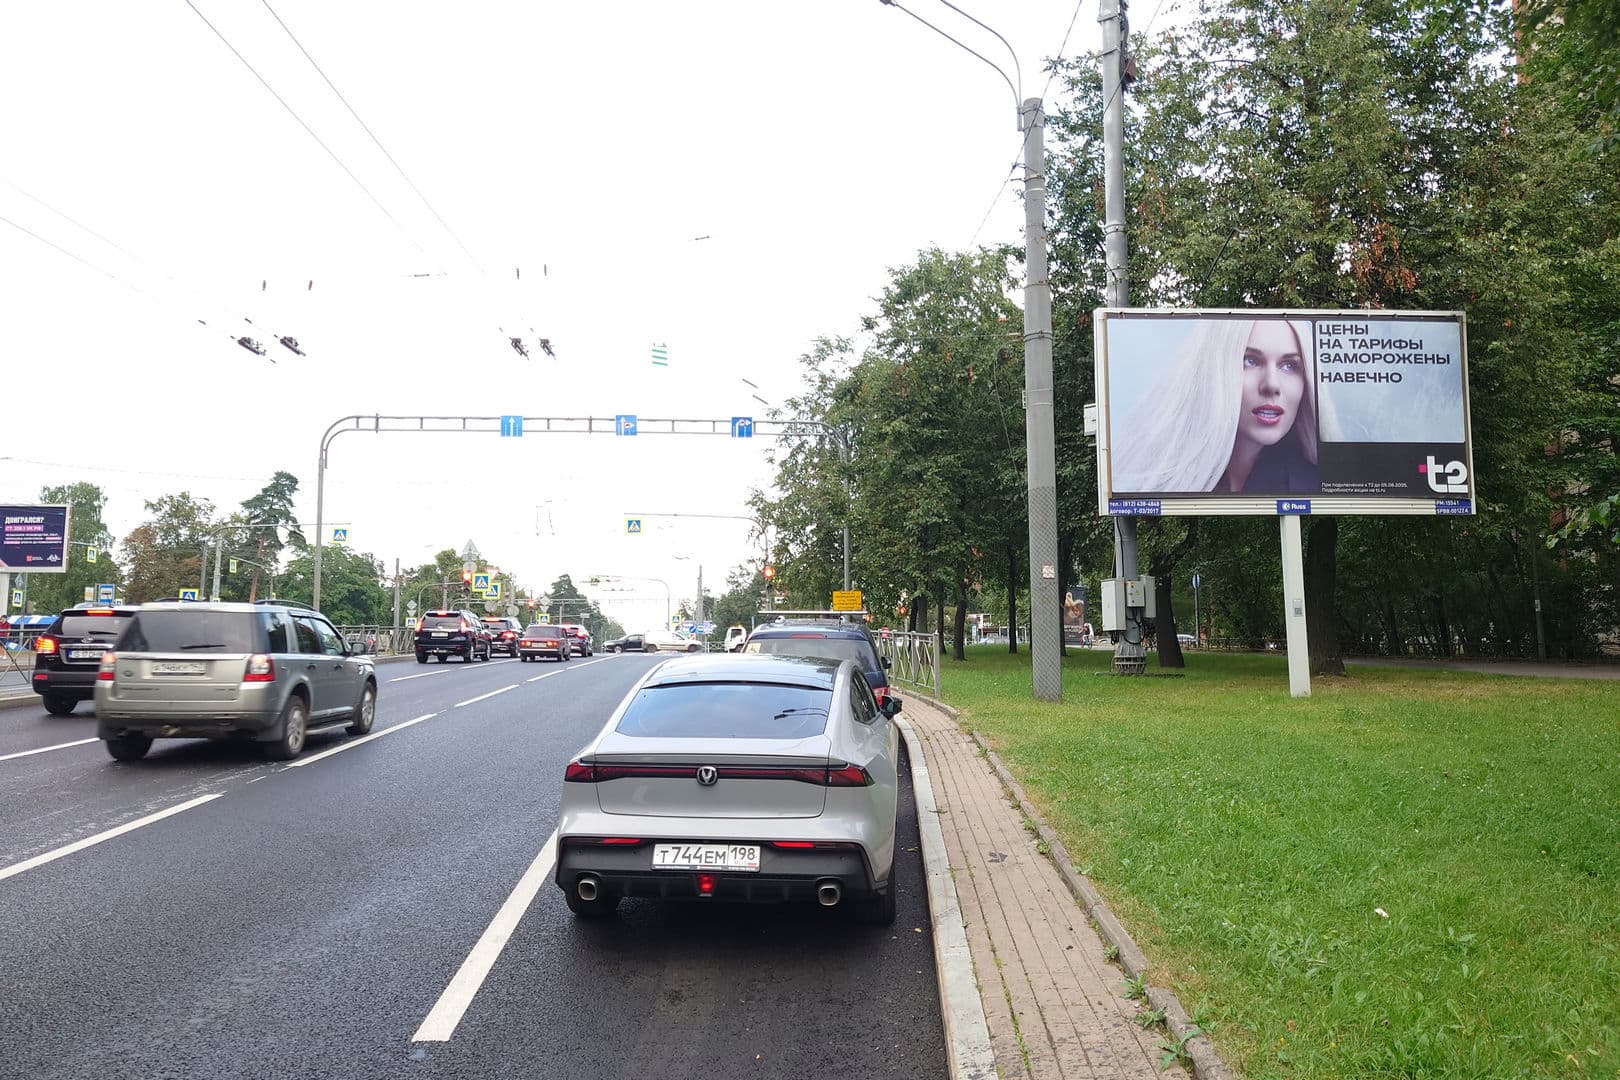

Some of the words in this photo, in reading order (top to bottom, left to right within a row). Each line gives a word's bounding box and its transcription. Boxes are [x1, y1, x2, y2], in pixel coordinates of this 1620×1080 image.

[1319, 324, 1369, 337] ЦЕНЫ
[1319, 338, 1343, 350] НА
[1348, 338, 1423, 350] ТАРИФЫ
[1319, 352, 1450, 365] ЗАМОРОЖЕНЫ
[1320, 372, 1403, 384] НАВЕЧНО
[730, 847, 756, 861] 198
